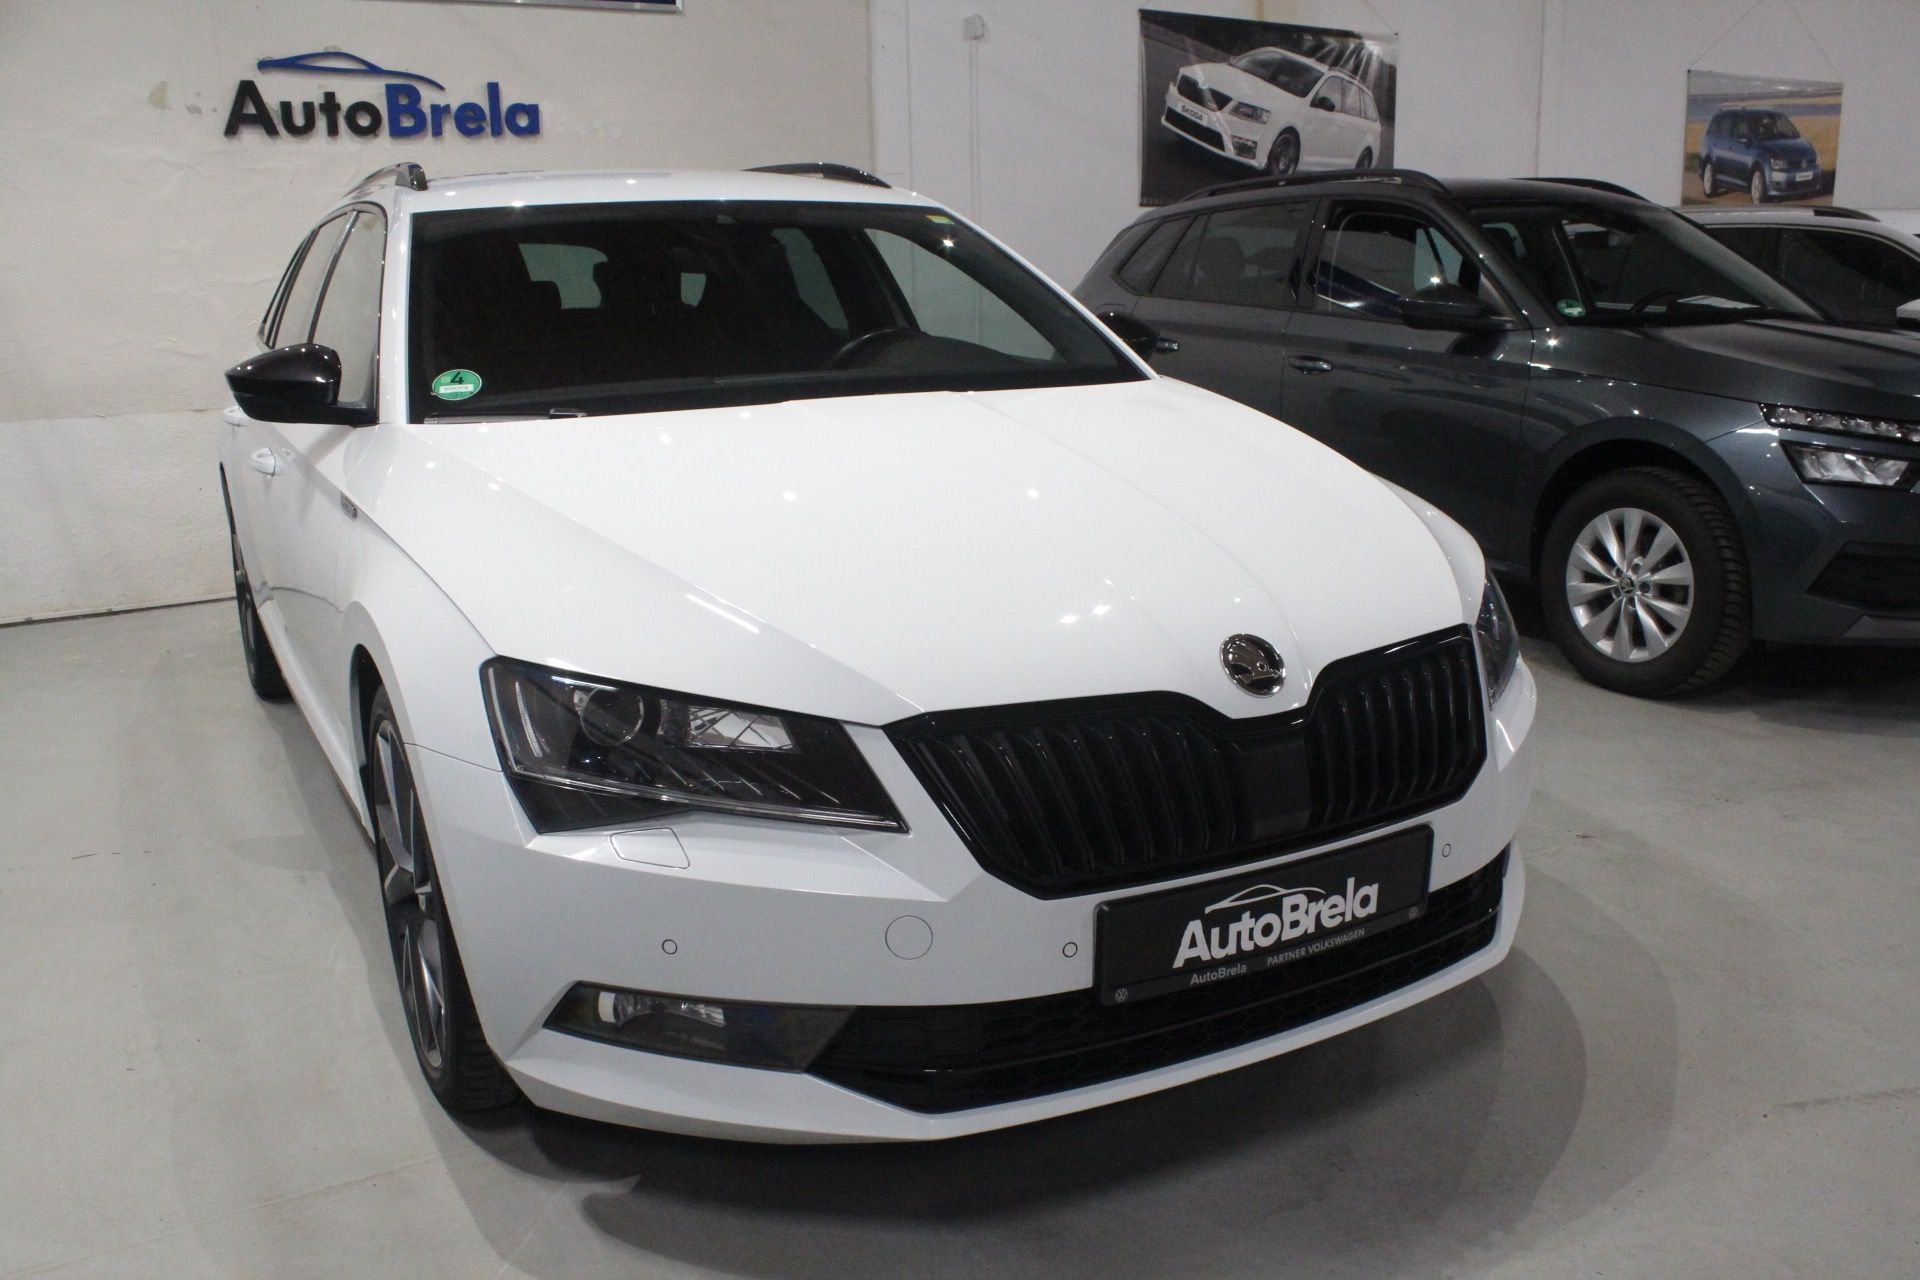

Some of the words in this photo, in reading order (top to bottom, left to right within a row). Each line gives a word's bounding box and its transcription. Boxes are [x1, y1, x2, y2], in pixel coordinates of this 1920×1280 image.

[224, 80, 541, 137] AutoBrela
[450, 372, 465, 385] 4
[1172, 877, 1379, 969] AutoBrela
[1190, 963, 1248, 986] AutoBrela
[1267, 947, 1306, 966] PARTNER
[1307, 927, 1366, 954] VOLKSWAGEN
